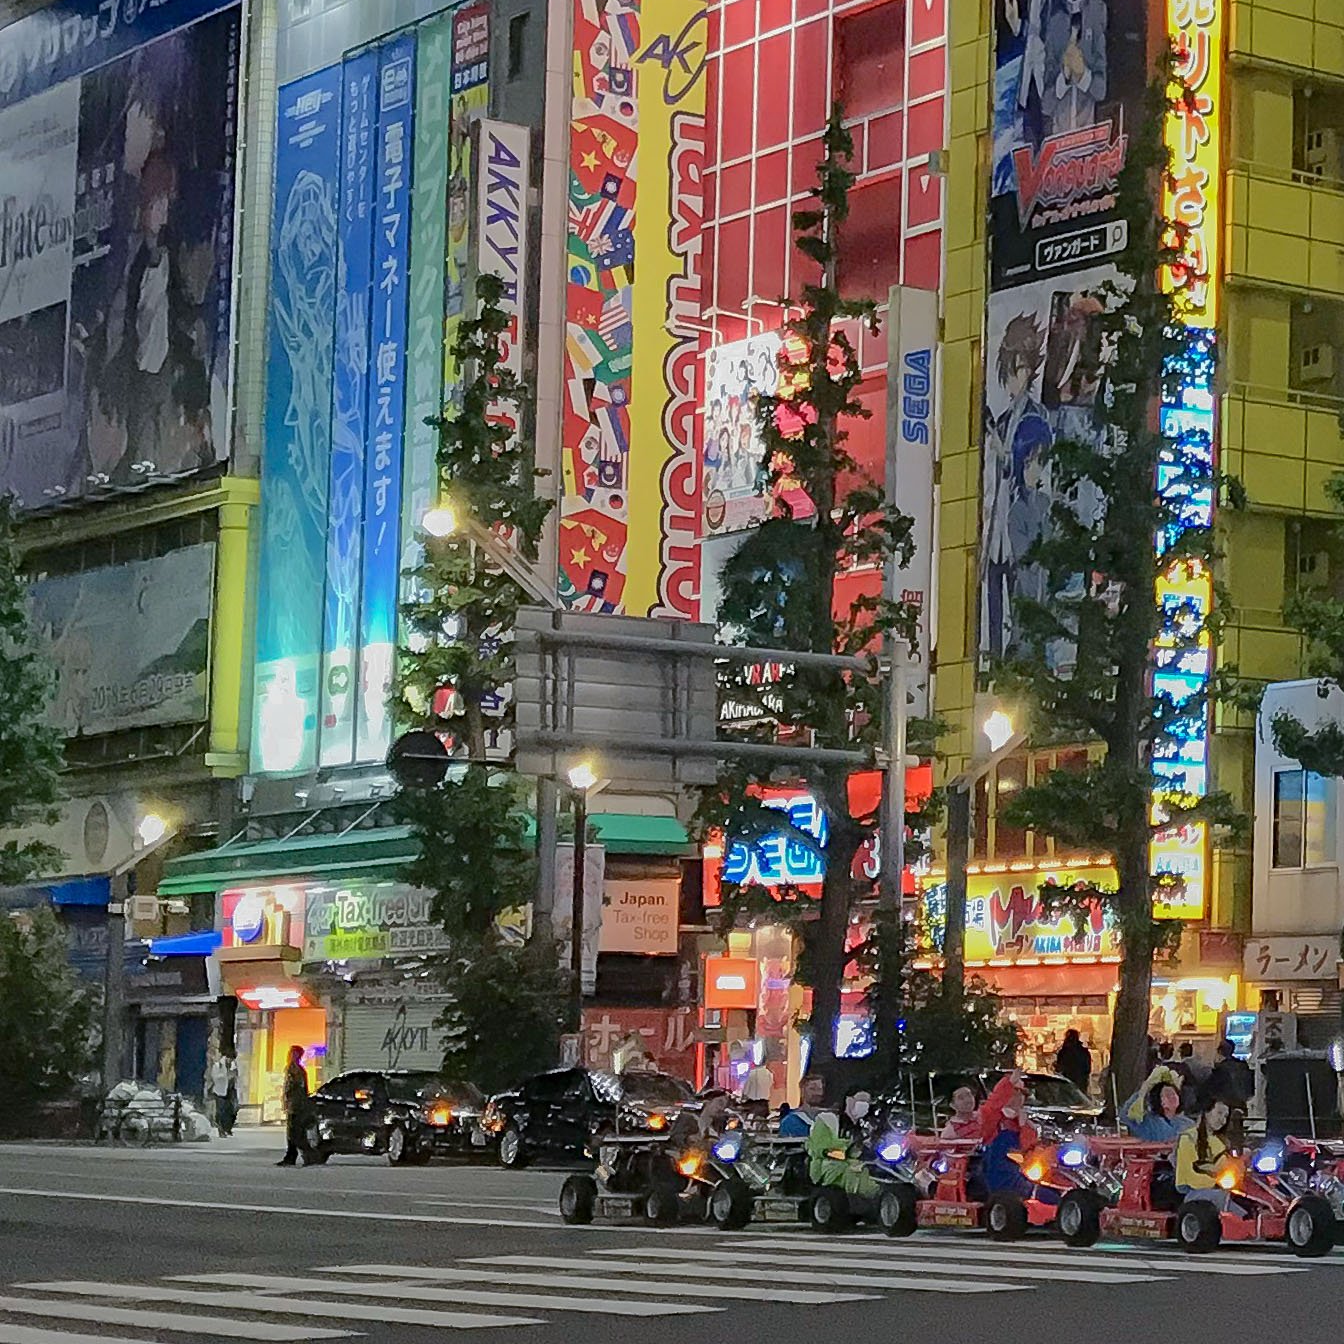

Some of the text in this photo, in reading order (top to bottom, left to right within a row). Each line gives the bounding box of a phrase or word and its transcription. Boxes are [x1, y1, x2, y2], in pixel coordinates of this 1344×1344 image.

[486, 131, 521, 274] AKKY
[1043, 235, 1100, 262] ヴァンガード
[902, 348, 931, 444] SEGA
[633, 926, 670, 943] Shop
[1255, 944, 1329, 976] ラーメン
